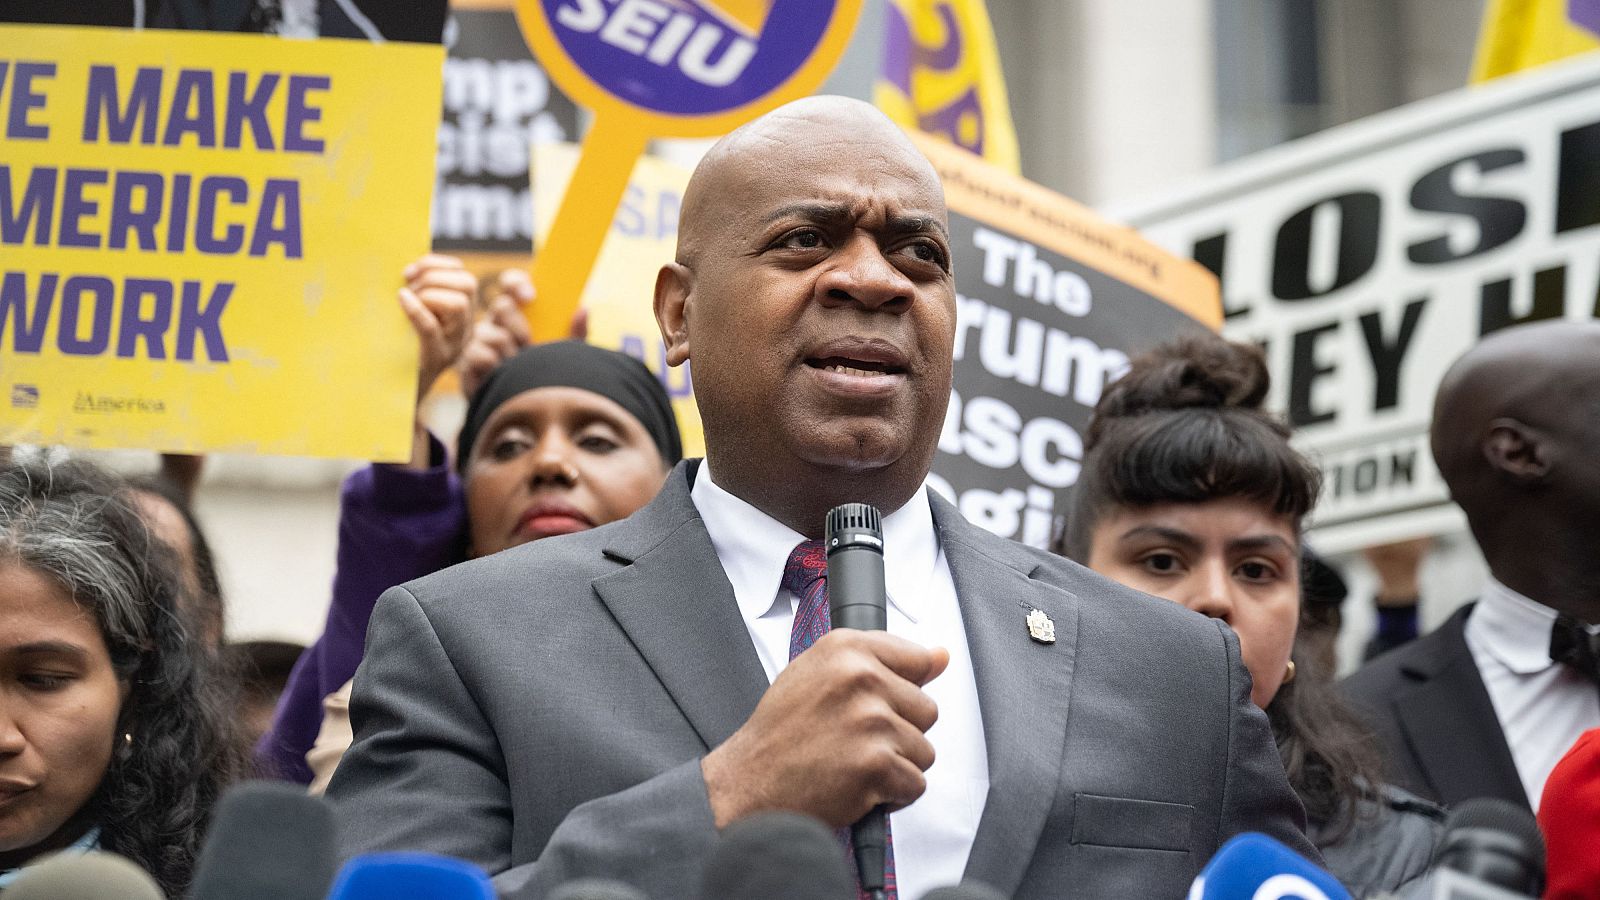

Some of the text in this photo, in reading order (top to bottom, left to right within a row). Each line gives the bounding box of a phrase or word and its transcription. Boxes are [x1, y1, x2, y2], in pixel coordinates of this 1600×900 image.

[556, 0, 758, 87] SEIU
[0, 61, 332, 154] E MAKE
[0, 272, 236, 363] WORK
[973, 226, 1092, 318] The
